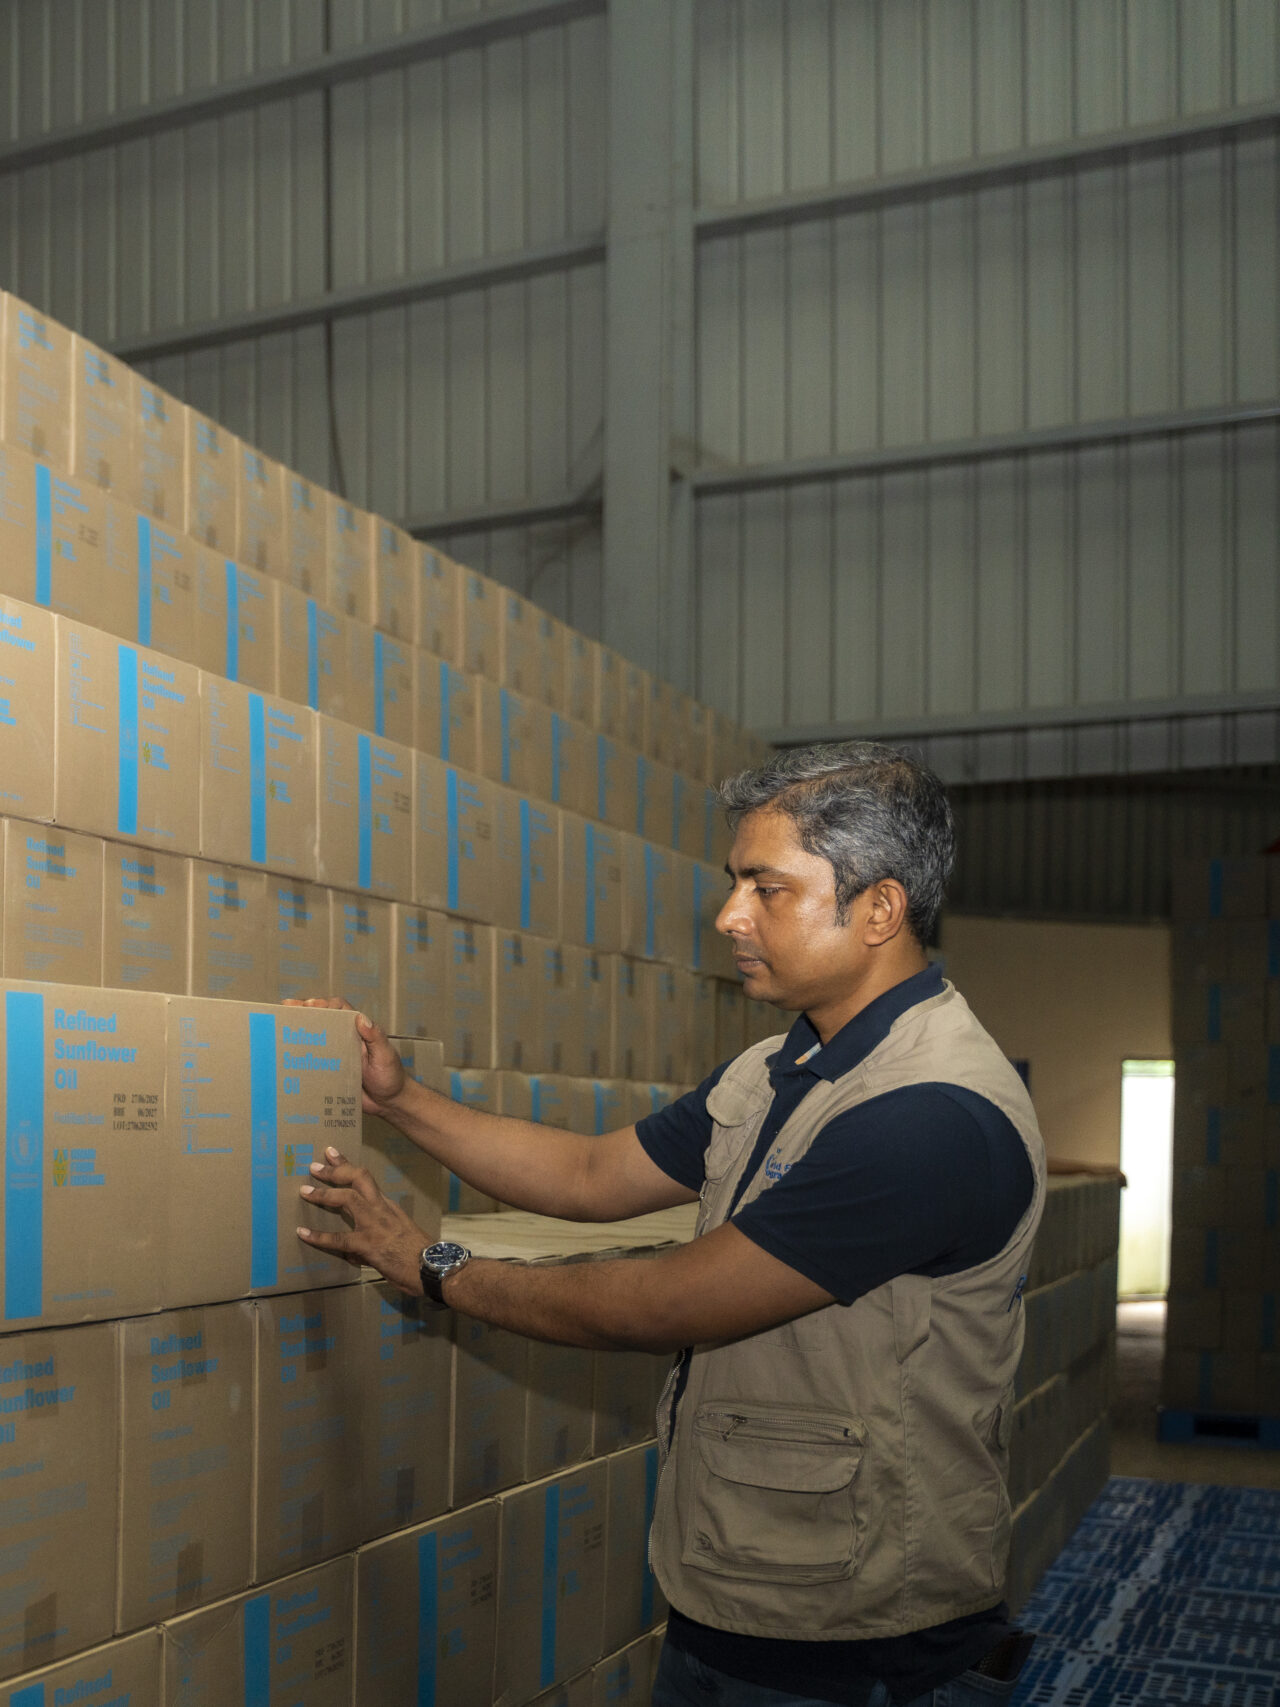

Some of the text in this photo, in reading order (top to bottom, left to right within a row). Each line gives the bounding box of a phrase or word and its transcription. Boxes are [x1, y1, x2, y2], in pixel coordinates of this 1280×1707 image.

[54, 1008, 116, 1033] Refined
[54, 1038, 137, 1063] Sunflower
[54, 1068, 77, 1089] Oil
